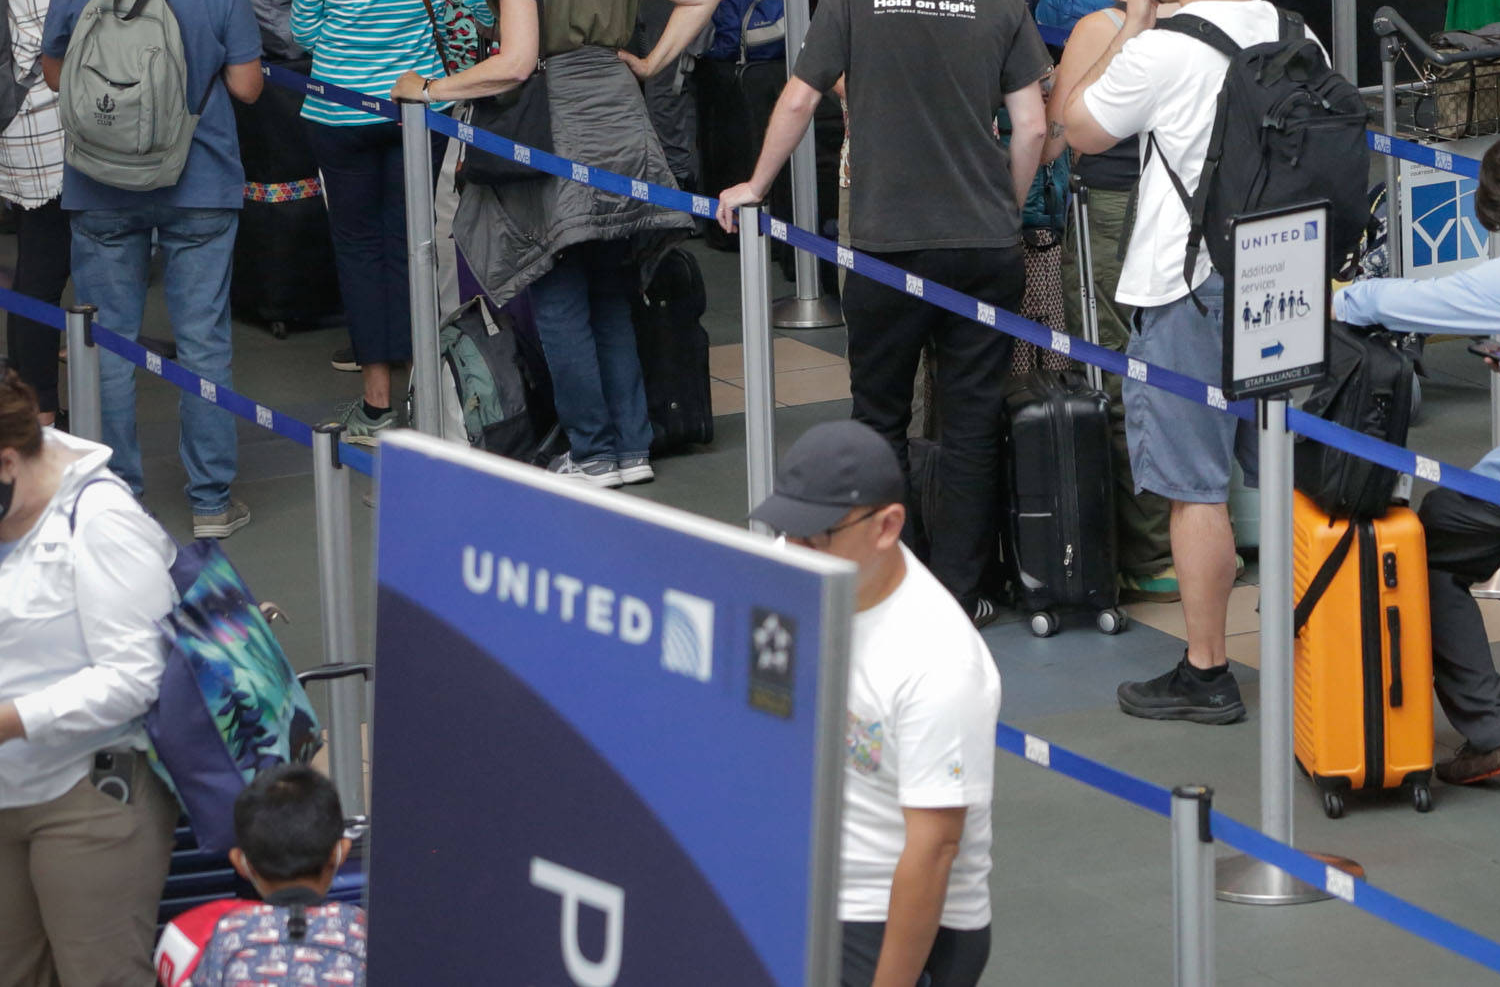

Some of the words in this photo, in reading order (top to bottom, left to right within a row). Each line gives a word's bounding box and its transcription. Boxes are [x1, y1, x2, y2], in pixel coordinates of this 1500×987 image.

[915, 0, 935, 9] on
[939, 1, 976, 13] tight
[1242, 229, 1300, 250] UNITED
[1241, 261, 1285, 279] Additional
[1241, 279, 1276, 294] services
[1244, 376, 1265, 388] STAR
[1265, 368, 1302, 383] ALLIANCE
[462, 545, 653, 646] UNITED
